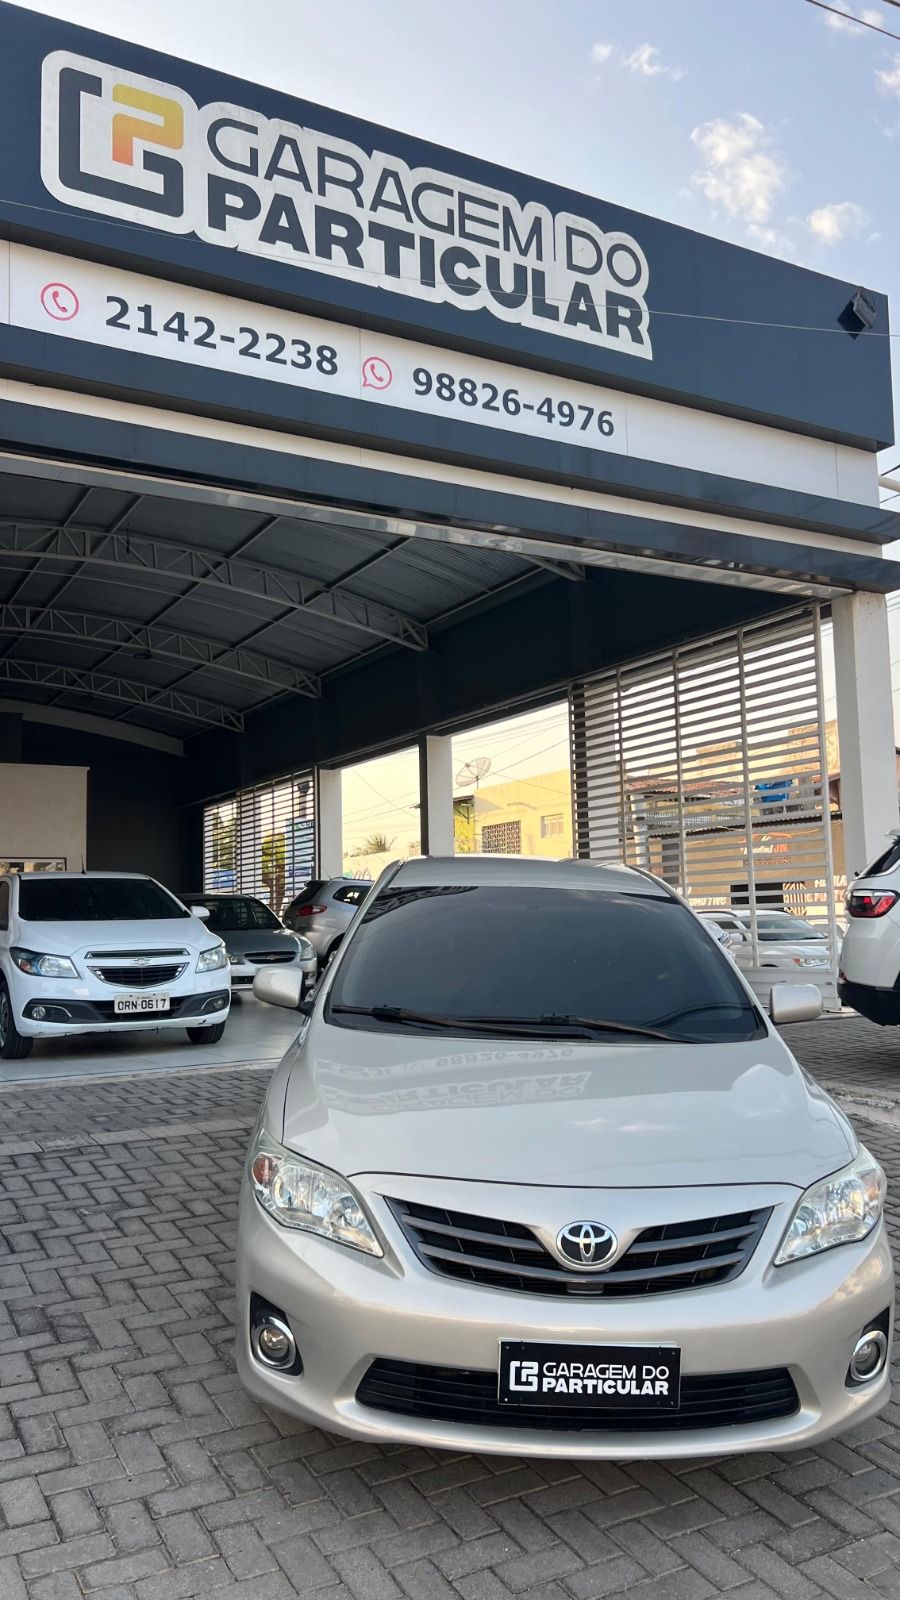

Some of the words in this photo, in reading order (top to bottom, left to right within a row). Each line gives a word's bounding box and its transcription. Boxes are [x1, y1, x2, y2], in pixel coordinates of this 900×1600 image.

[206, 118, 543, 261] GARAGEM
[567, 227, 642, 288] DO
[207, 174, 643, 345] PARTICULAR
[105, 296, 338, 376] 2142-2238
[412, 367, 615, 437] 98826-4976
[542, 1377, 669, 1395] PARTICULAR
[543, 1362, 636, 1379] GARAGEM
[642, 1365, 669, 1380] DO
